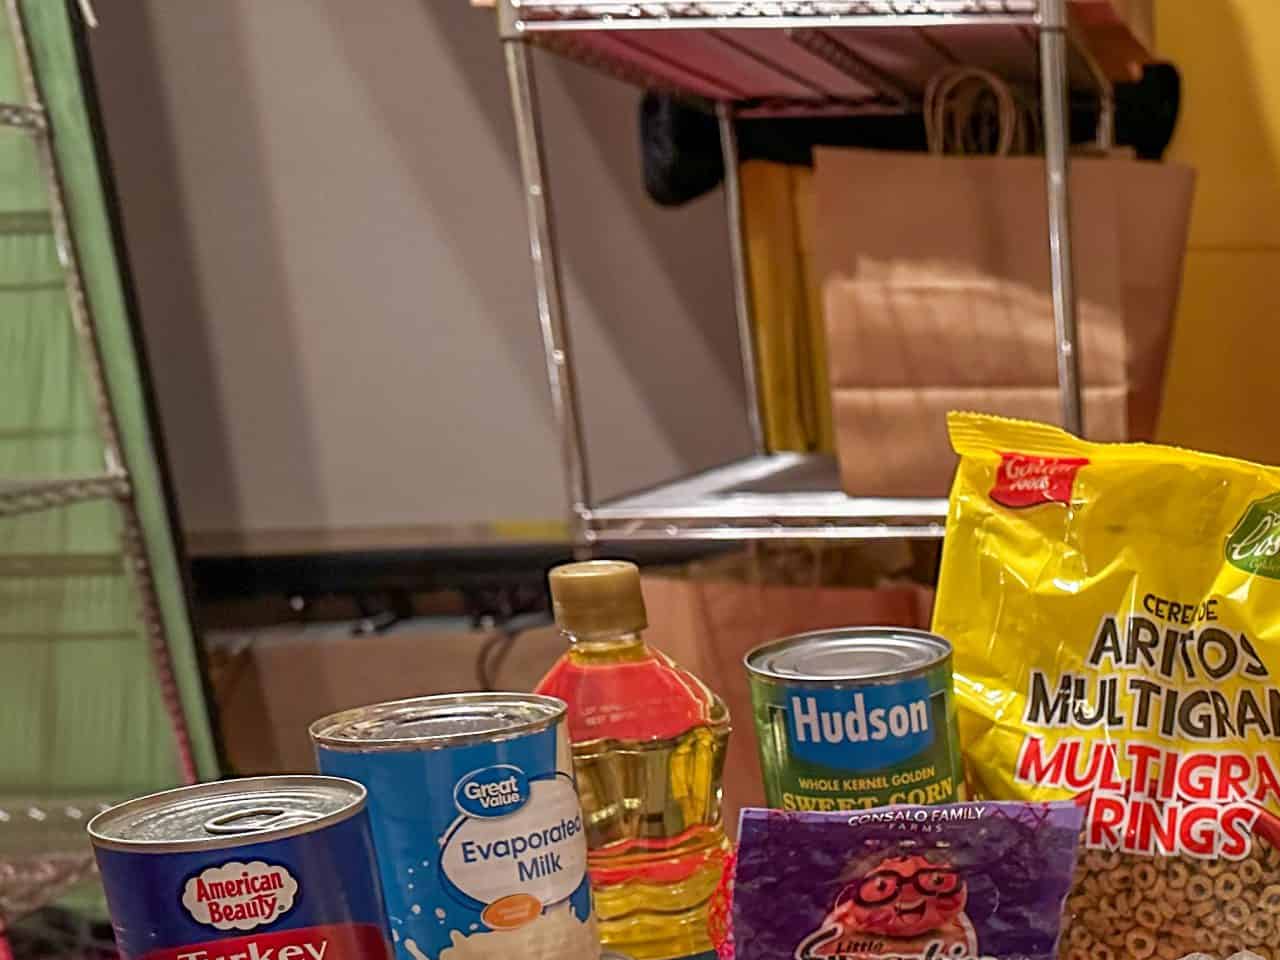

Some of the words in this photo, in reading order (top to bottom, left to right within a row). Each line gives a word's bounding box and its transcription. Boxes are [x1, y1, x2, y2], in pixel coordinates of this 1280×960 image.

[792, 692, 928, 744] Hudson
[464, 776, 518, 800] Great
[783, 792, 878, 811] SWEET
[889, 777, 953, 806] CORN
[799, 778, 840, 791] WHOLE
[842, 775, 889, 791] KERNEL
[892, 768, 936, 786] GOLDEN
[480, 792, 520, 809] Value
[848, 810, 928, 826] CONSALO
[931, 806, 985, 822] FAMILY
[889, 823, 943, 833] FARMS
[1088, 799, 1256, 857] RINGS
[517, 852, 562, 883] Milk
[197, 871, 284, 903] American
[207, 892, 277, 923] Beauty
